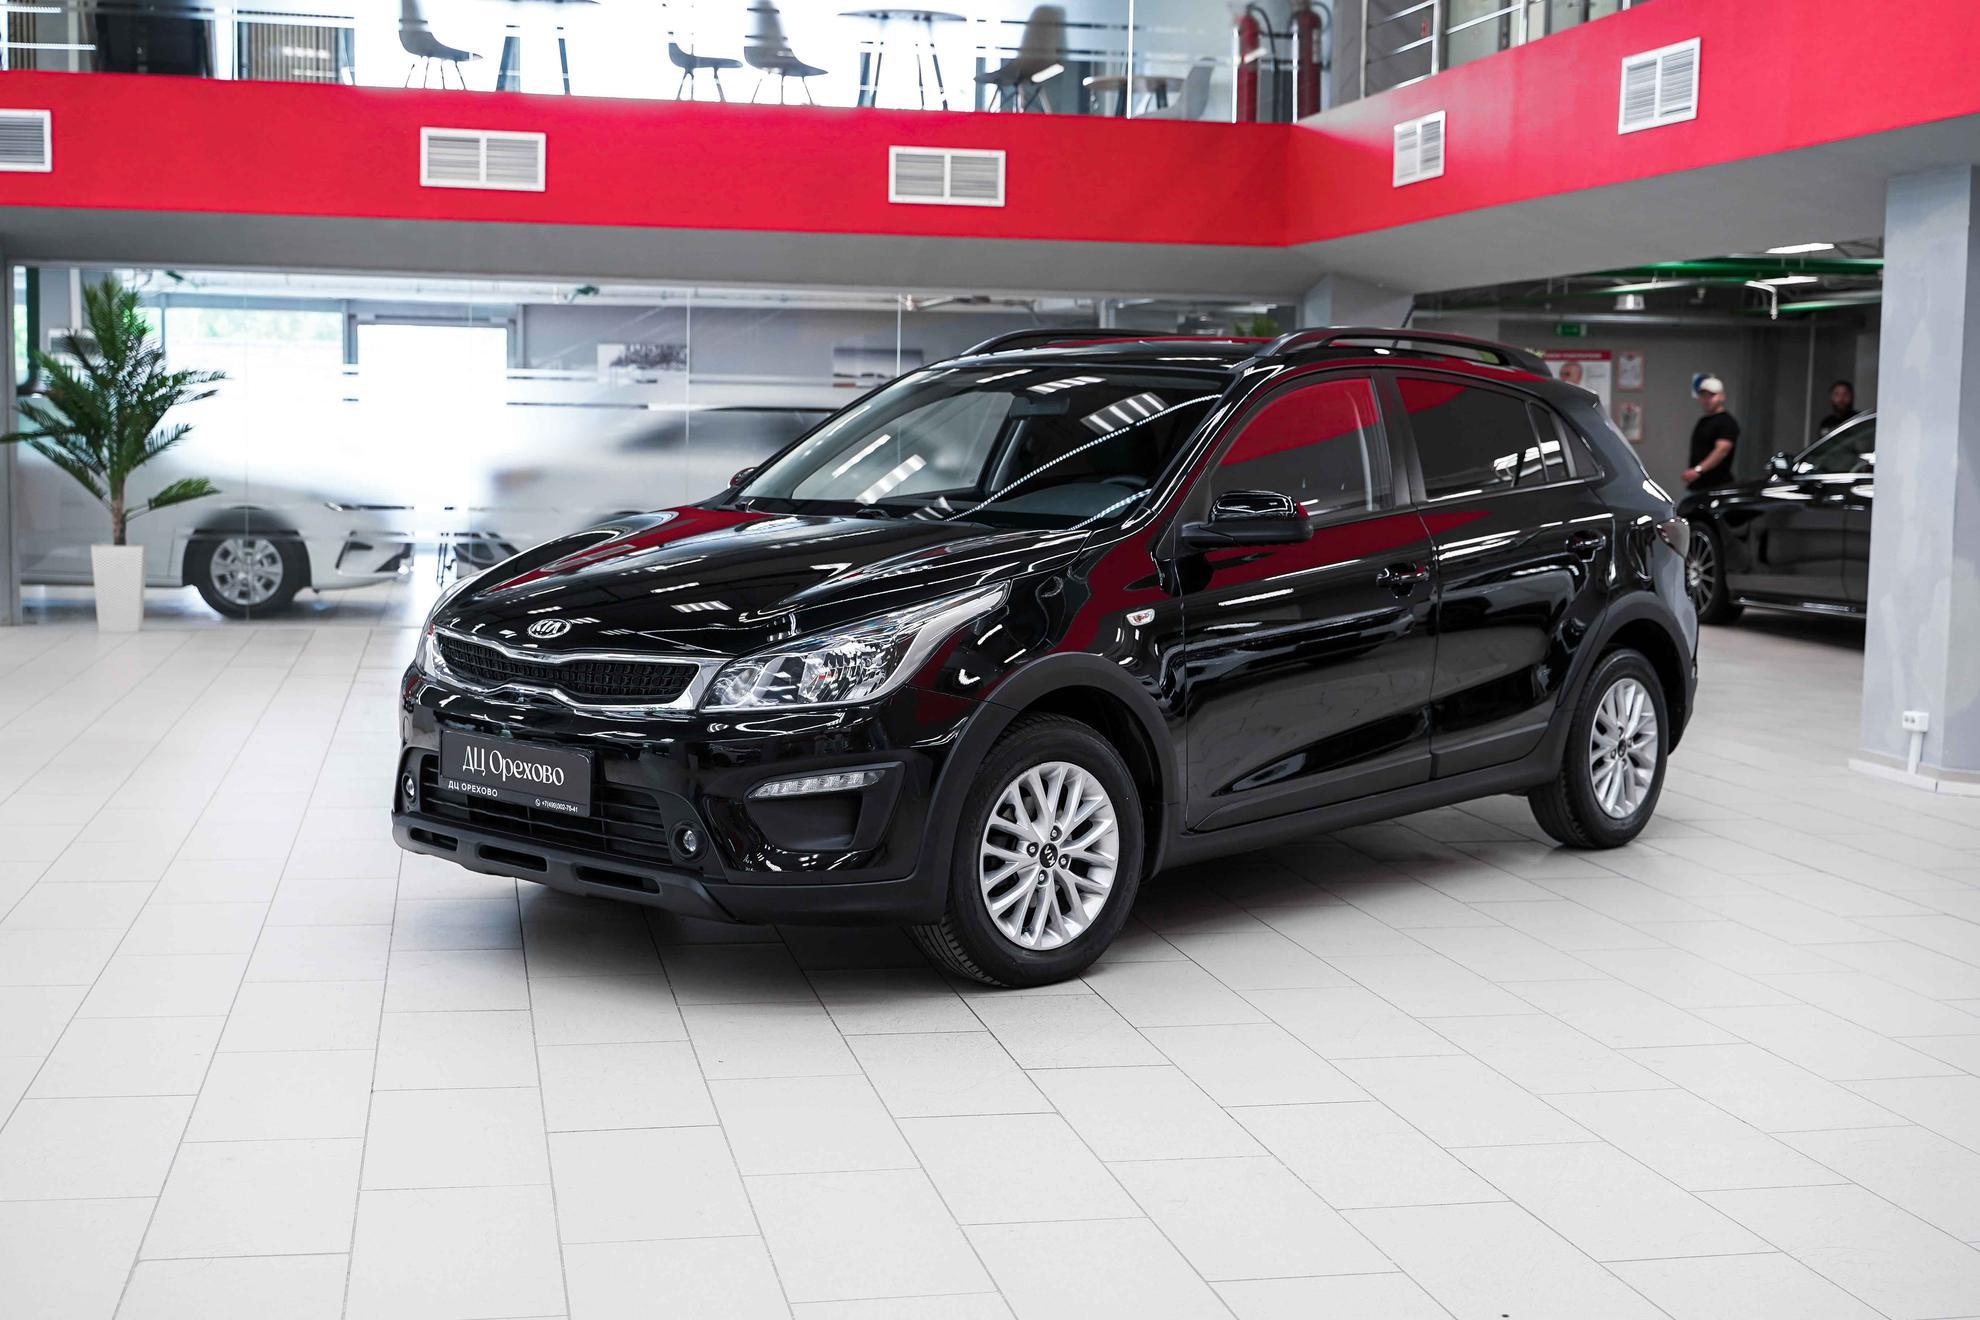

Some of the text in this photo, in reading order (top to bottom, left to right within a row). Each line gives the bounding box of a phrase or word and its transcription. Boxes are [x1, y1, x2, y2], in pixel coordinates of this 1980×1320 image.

[530, 620, 565, 635] KIA
[462, 745, 565, 786] ДЦ Орехово
[448, 780, 498, 797] ДЦ ОРЕХОВО
[1044, 845, 1056, 866] KIA
